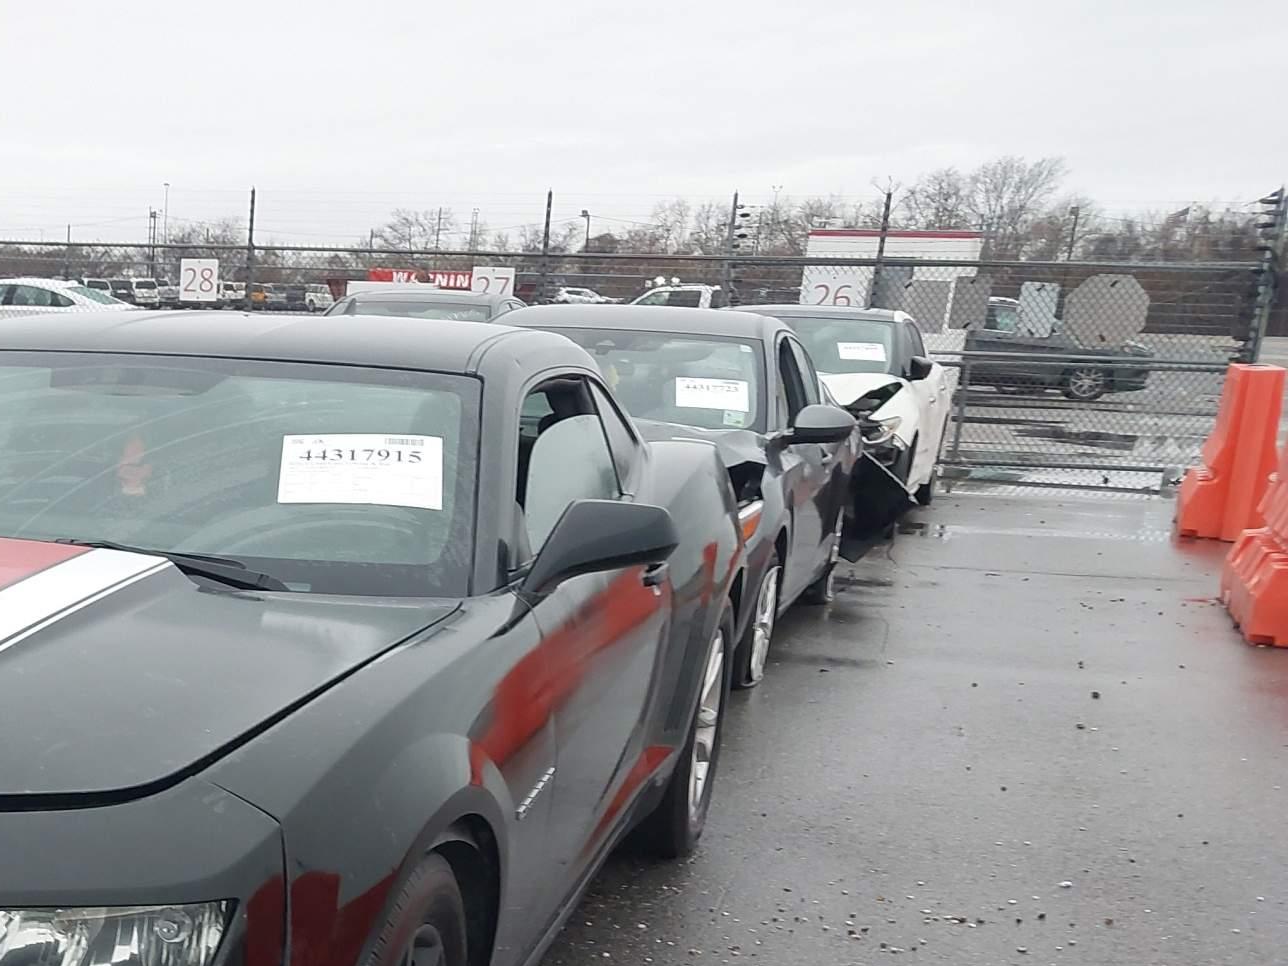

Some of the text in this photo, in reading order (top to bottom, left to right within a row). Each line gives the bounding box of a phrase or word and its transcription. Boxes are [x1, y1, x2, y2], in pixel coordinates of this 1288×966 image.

[183, 266, 214, 293] 28
[477, 276, 511, 295] 27
[814, 284, 852, 306] 26
[299, 449, 422, 463] 44317915
